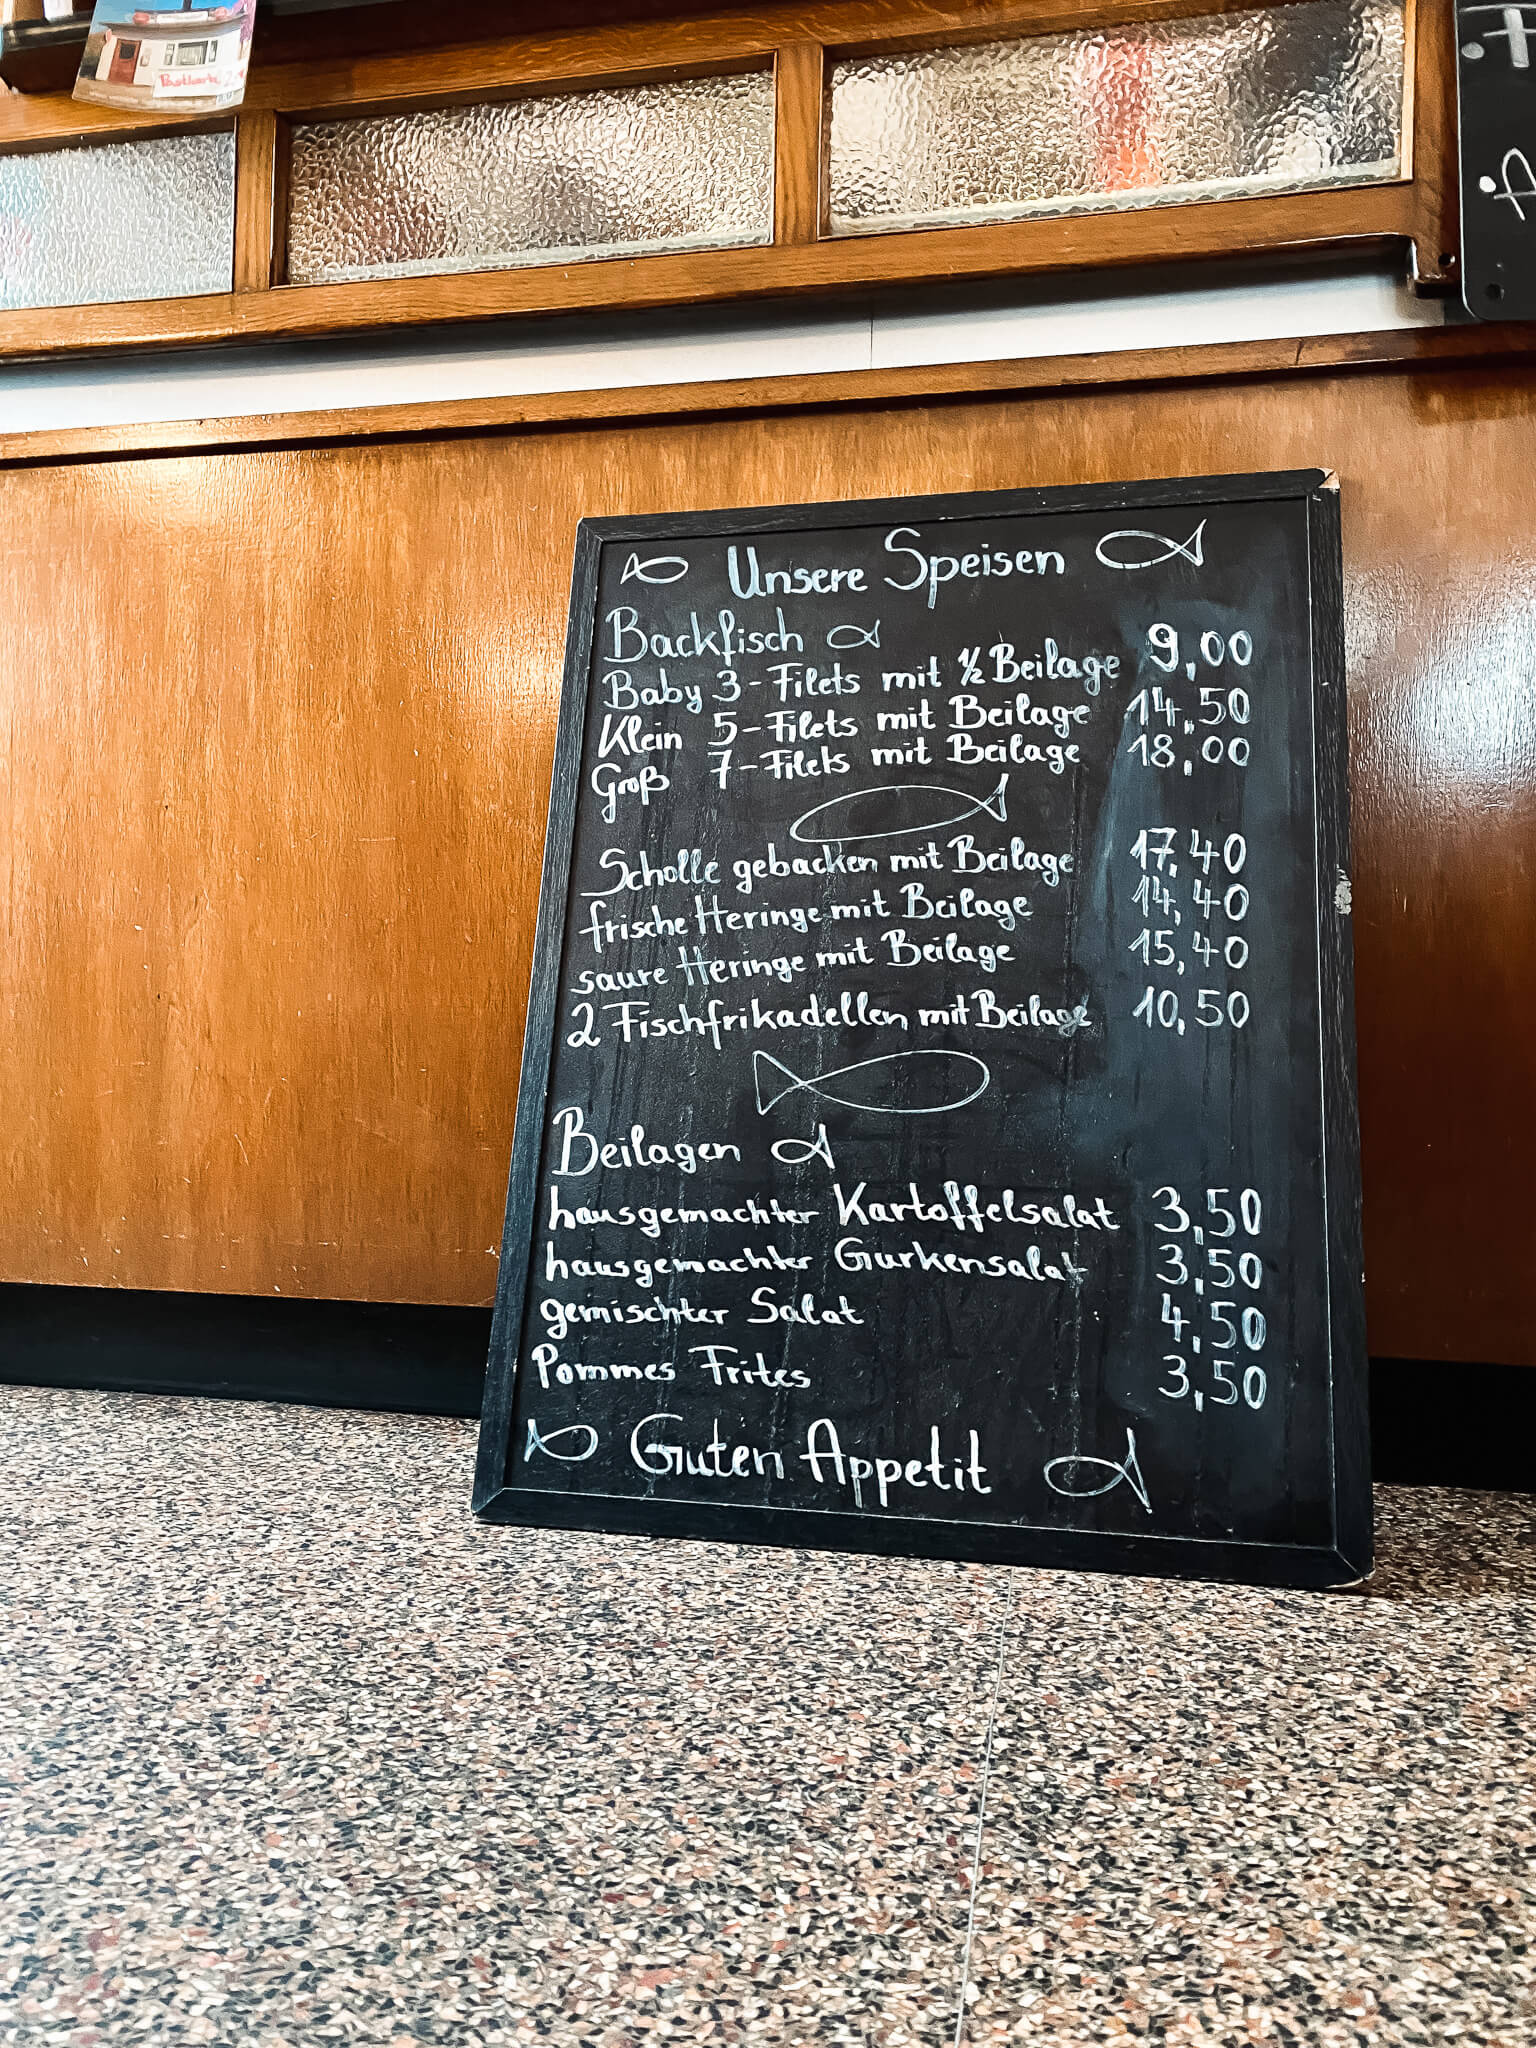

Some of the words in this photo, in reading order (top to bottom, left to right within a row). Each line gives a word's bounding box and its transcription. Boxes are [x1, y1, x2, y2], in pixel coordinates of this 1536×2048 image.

[728, 546, 868, 599] Unsere
[884, 528, 1064, 608] Speisen
[603, 606, 803, 666] Backfisch
[603, 670, 702, 713] Baby
[882, 656, 941, 691] mit
[989, 638, 1120, 696] Beilage
[1149, 623, 1252, 681] 9,00
[598, 714, 682, 758] Klein
[877, 699, 935, 731] mit
[948, 693, 1091, 738] Beilage
[1123, 687, 1250, 734] 14,50
[592, 763, 670, 823] Groß
[871, 738, 932, 766] mit
[946, 733, 1080, 774] Beilage
[1127, 734, 1250, 776] 18,00
[580, 848, 721, 897] Scholle
[733, 843, 878, 894] gebacken
[890, 843, 943, 872] mit
[947, 835, 1074, 886] Beilage
[1130, 827, 1246, 878] 17,40
[579, 900, 688, 953] frische
[695, 895, 822, 933] Heringe
[830, 890, 891, 919] mit
[900, 883, 1033, 931] Beilage
[1132, 875, 1249, 926] 14,40
[570, 965, 669, 994] saure
[676, 946, 806, 986] Heringe
[815, 937, 874, 968] mit
[881, 929, 1015, 973] Beilage
[1128, 928, 1249, 975] 15,40
[567, 1002, 600, 1047] 2
[602, 991, 908, 1050] Fischfrikadellen
[918, 994, 970, 1027] mit
[971, 988, 1092, 1036] Beilage
[1132, 986, 1250, 1035] 10,50
[551, 1106, 741, 1176] Beilagen
[548, 1185, 820, 1238] hausgemachter
[833, 1181, 1121, 1233] Kartoffelsalat
[1151, 1186, 1262, 1245] 3,50
[545, 1241, 813, 1287] hausgemachter
[835, 1237, 1088, 1282] Gurkensalat
[1156, 1244, 1262, 1295] 3,50
[540, 1296, 729, 1339] gemischter
[747, 1287, 864, 1325] Salat
[1161, 1293, 1266, 1353] 4,50
[531, 1343, 675, 1389] Pommes
[688, 1345, 811, 1388] Frites
[1158, 1355, 1266, 1411] 3,50
[630, 1413, 783, 1479] Guten
[800, 1418, 992, 1508] Appetit
